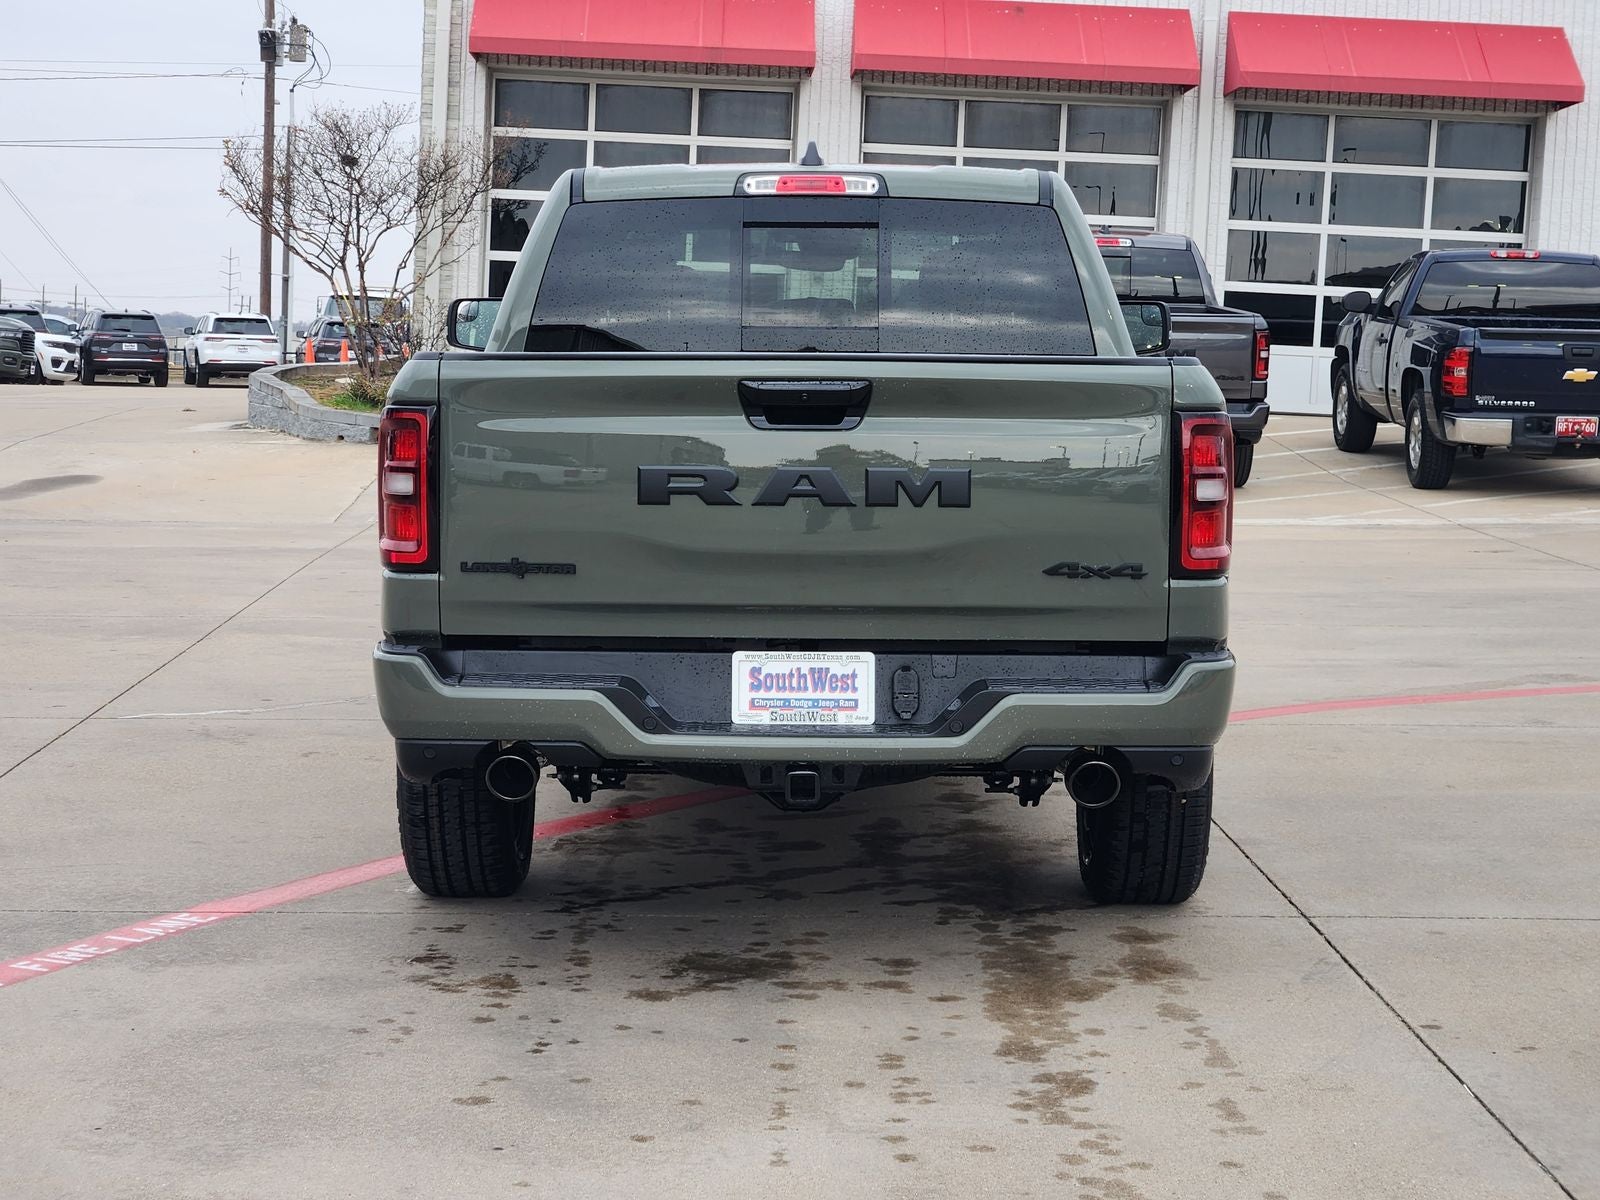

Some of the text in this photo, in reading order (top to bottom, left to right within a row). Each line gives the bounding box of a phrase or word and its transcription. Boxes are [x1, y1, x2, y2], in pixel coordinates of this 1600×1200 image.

[1558, 422, 1596, 433] RFY 760
[637, 465, 972, 508] RAM
[1041, 561, 1149, 580] 4x4
[748, 666, 859, 694] SouthWest
[754, 699, 855, 708] Chrysler Dodge Jeep Ram
[770, 711, 839, 722] SouthWest
[8, 912, 220, 973] FIRE LANE
